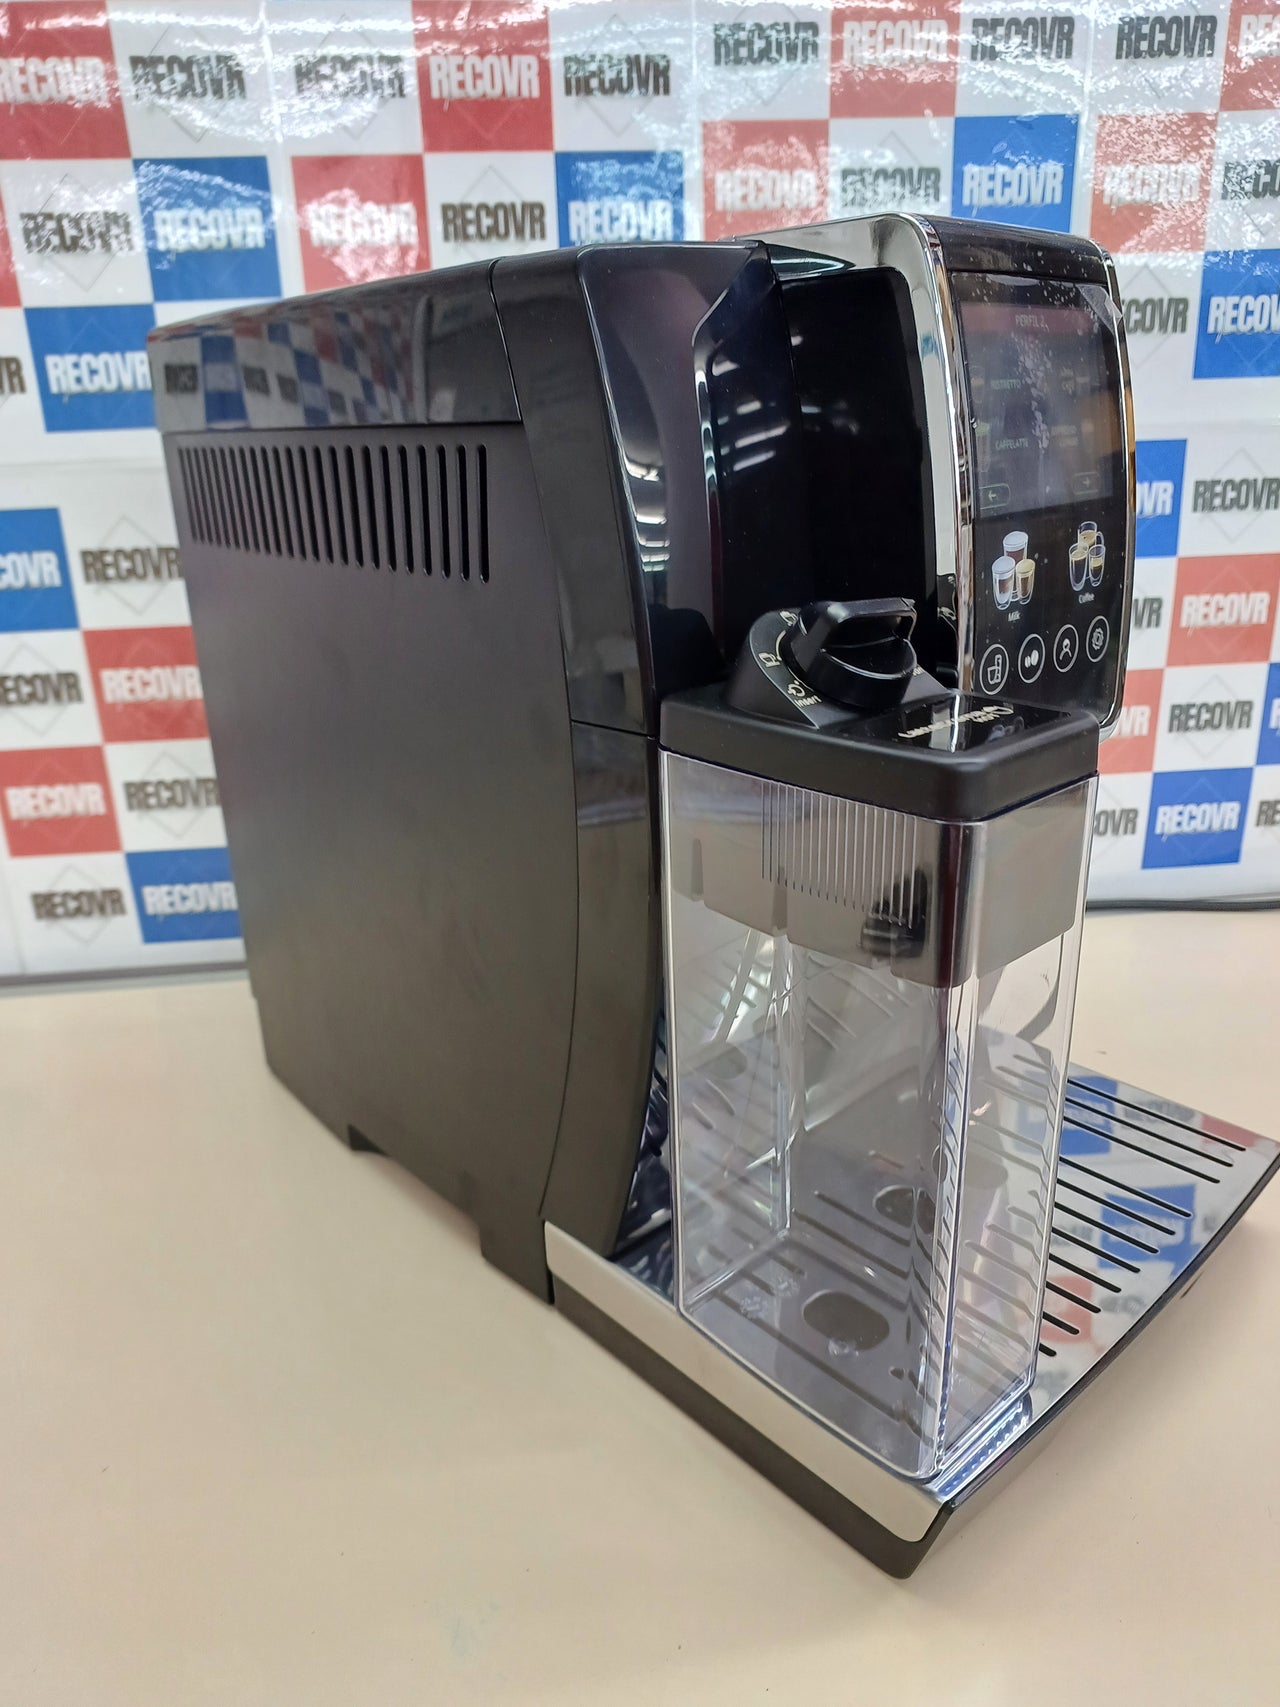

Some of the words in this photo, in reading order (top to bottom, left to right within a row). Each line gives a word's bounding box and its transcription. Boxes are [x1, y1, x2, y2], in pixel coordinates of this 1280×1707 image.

[713, 21, 819, 66] RECOVR
[842, 19, 949, 67] RECOVR
[971, 15, 1075, 61] RECOVR
[1115, 14, 1218, 60] RECOVR
[428, 54, 540, 99] RECOVR
[563, 53, 672, 97] RECOVR
[714, 169, 816, 212] RECOVR
[962, 162, 1065, 207] RECOVR
[154, 206, 265, 254] RECOVR
[440, 201, 546, 243] RECOVR
[567, 200, 674, 241] RECOVR
[1122, 297, 1190, 335] COVR
[45, 350, 152, 395] RECOVR
[1192, 477, 1280, 514] RECOVR
[80, 546, 186, 584] RECOVR
[1008, 611, 1021, 622] Milk
[1180, 591, 1271, 628] RECOVR
[99, 663, 204, 704] RECOVR
[794, 694, 822, 709] Insert
[1168, 699, 1254, 734] RECOVR
[5, 782, 107, 821] RECOVR
[124, 777, 222, 812] RECOVR
[1155, 800, 1242, 837] RECOVR
[31, 888, 127, 921] RECOVR
[141, 880, 239, 916] RECOVR
